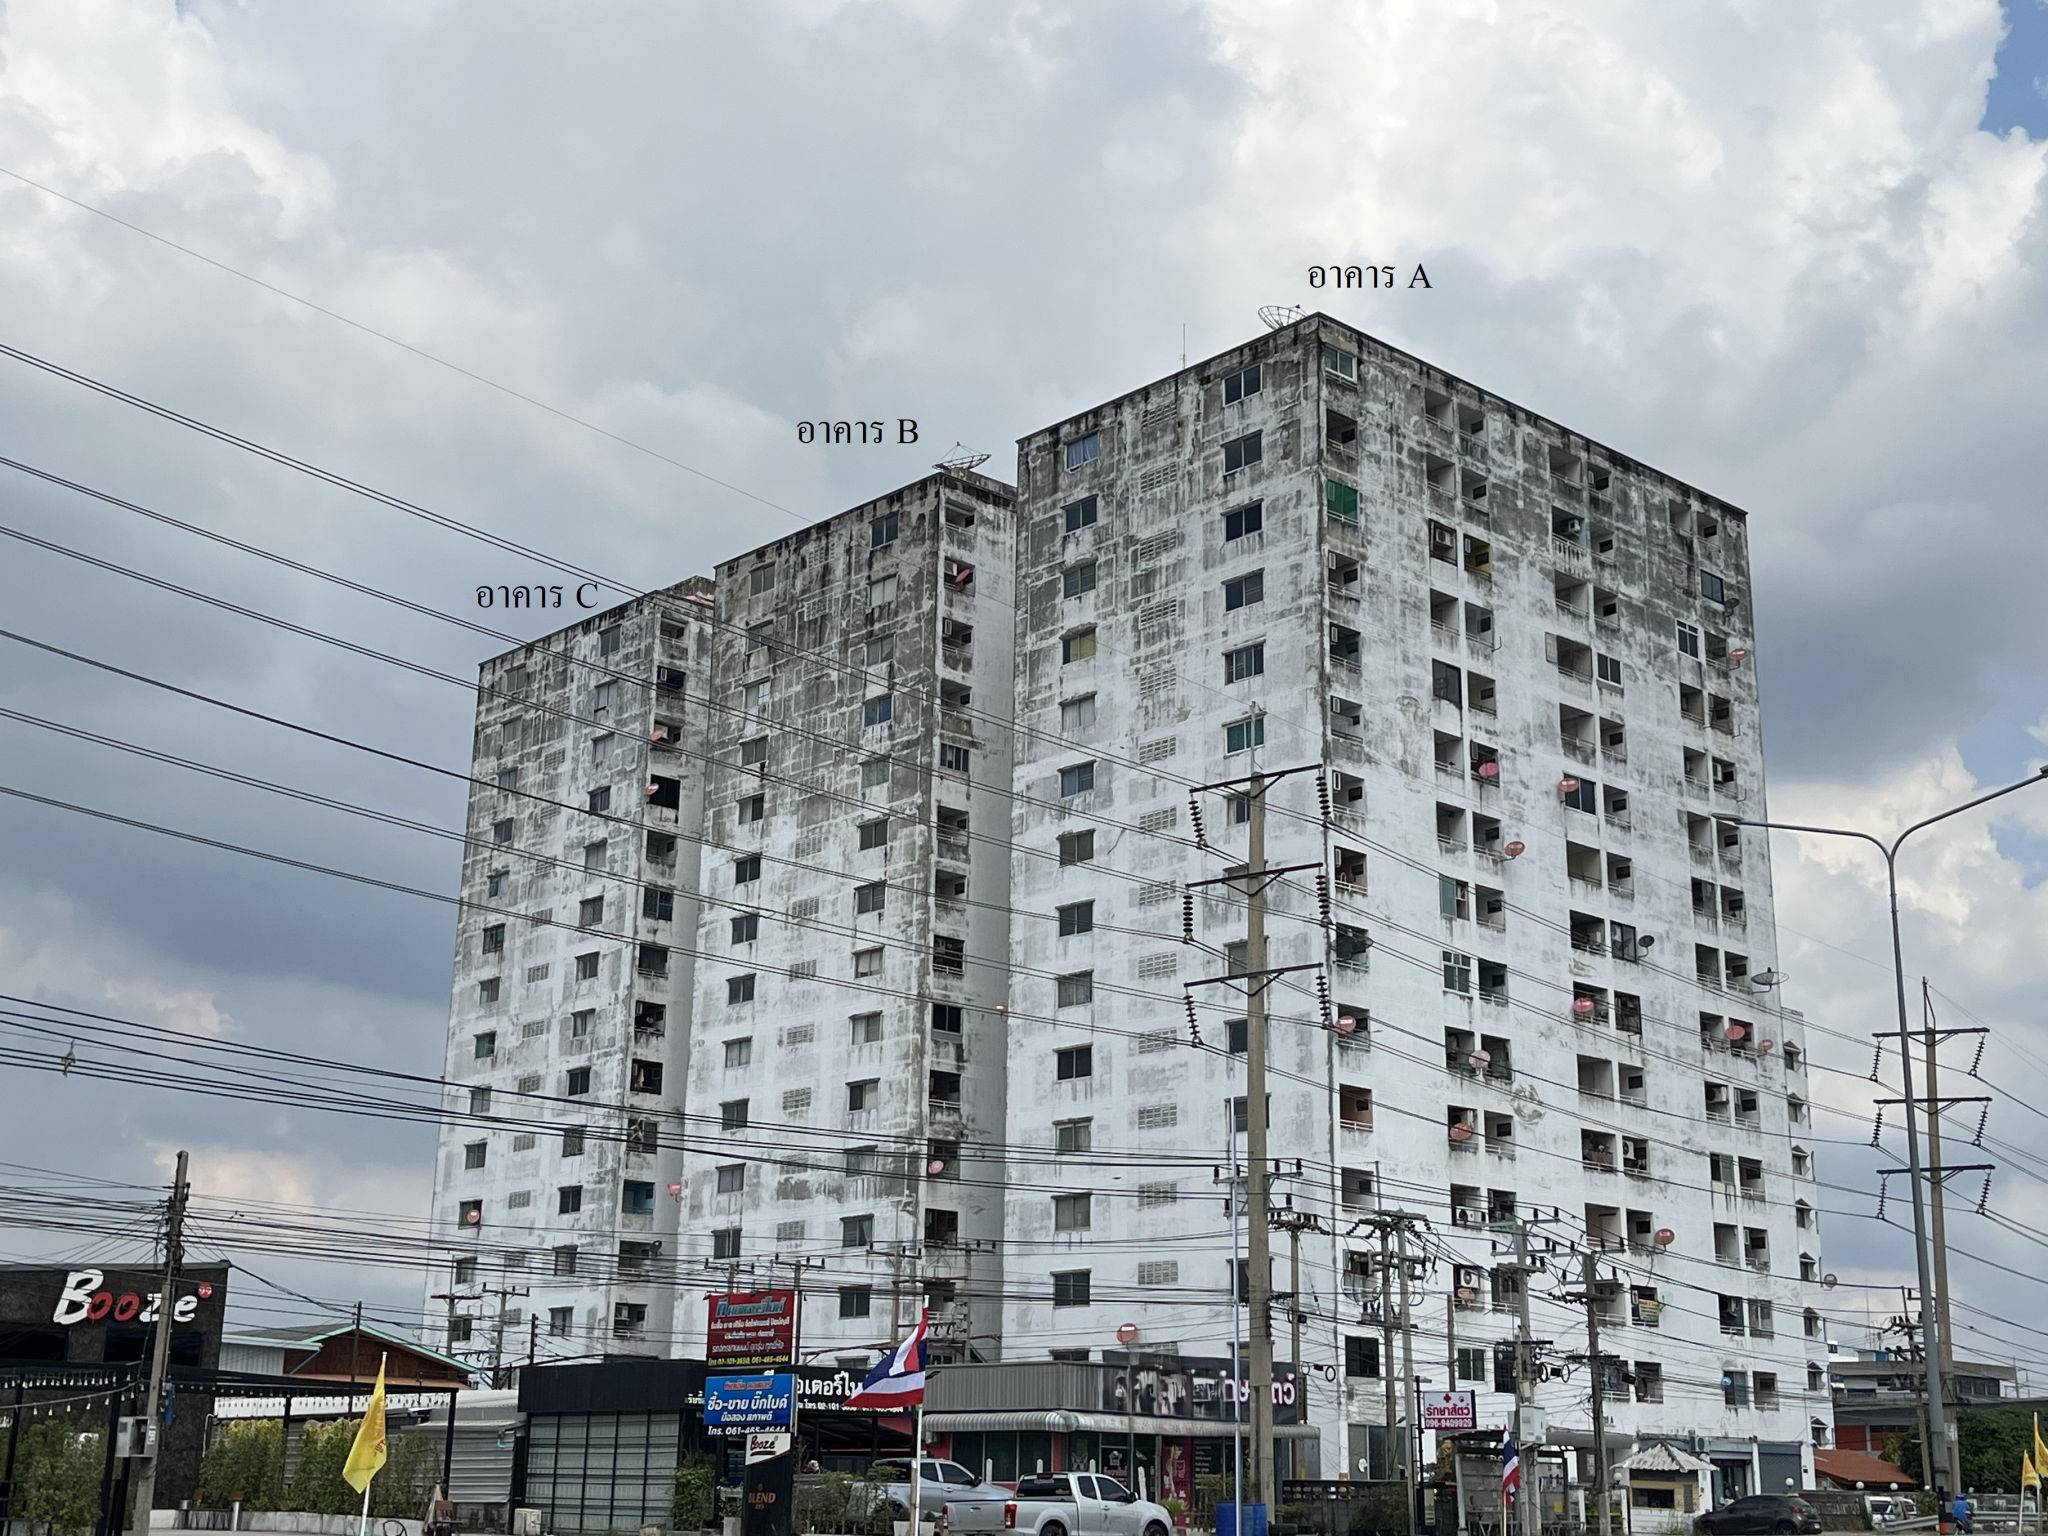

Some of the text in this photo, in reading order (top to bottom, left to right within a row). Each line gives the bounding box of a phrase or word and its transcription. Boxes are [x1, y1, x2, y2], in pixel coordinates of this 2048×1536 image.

[53, 1268, 198, 1326] Booze
[1426, 1403, 1471, 1417] รักษาสัตว์
[750, 1435, 776, 1451] Booze
